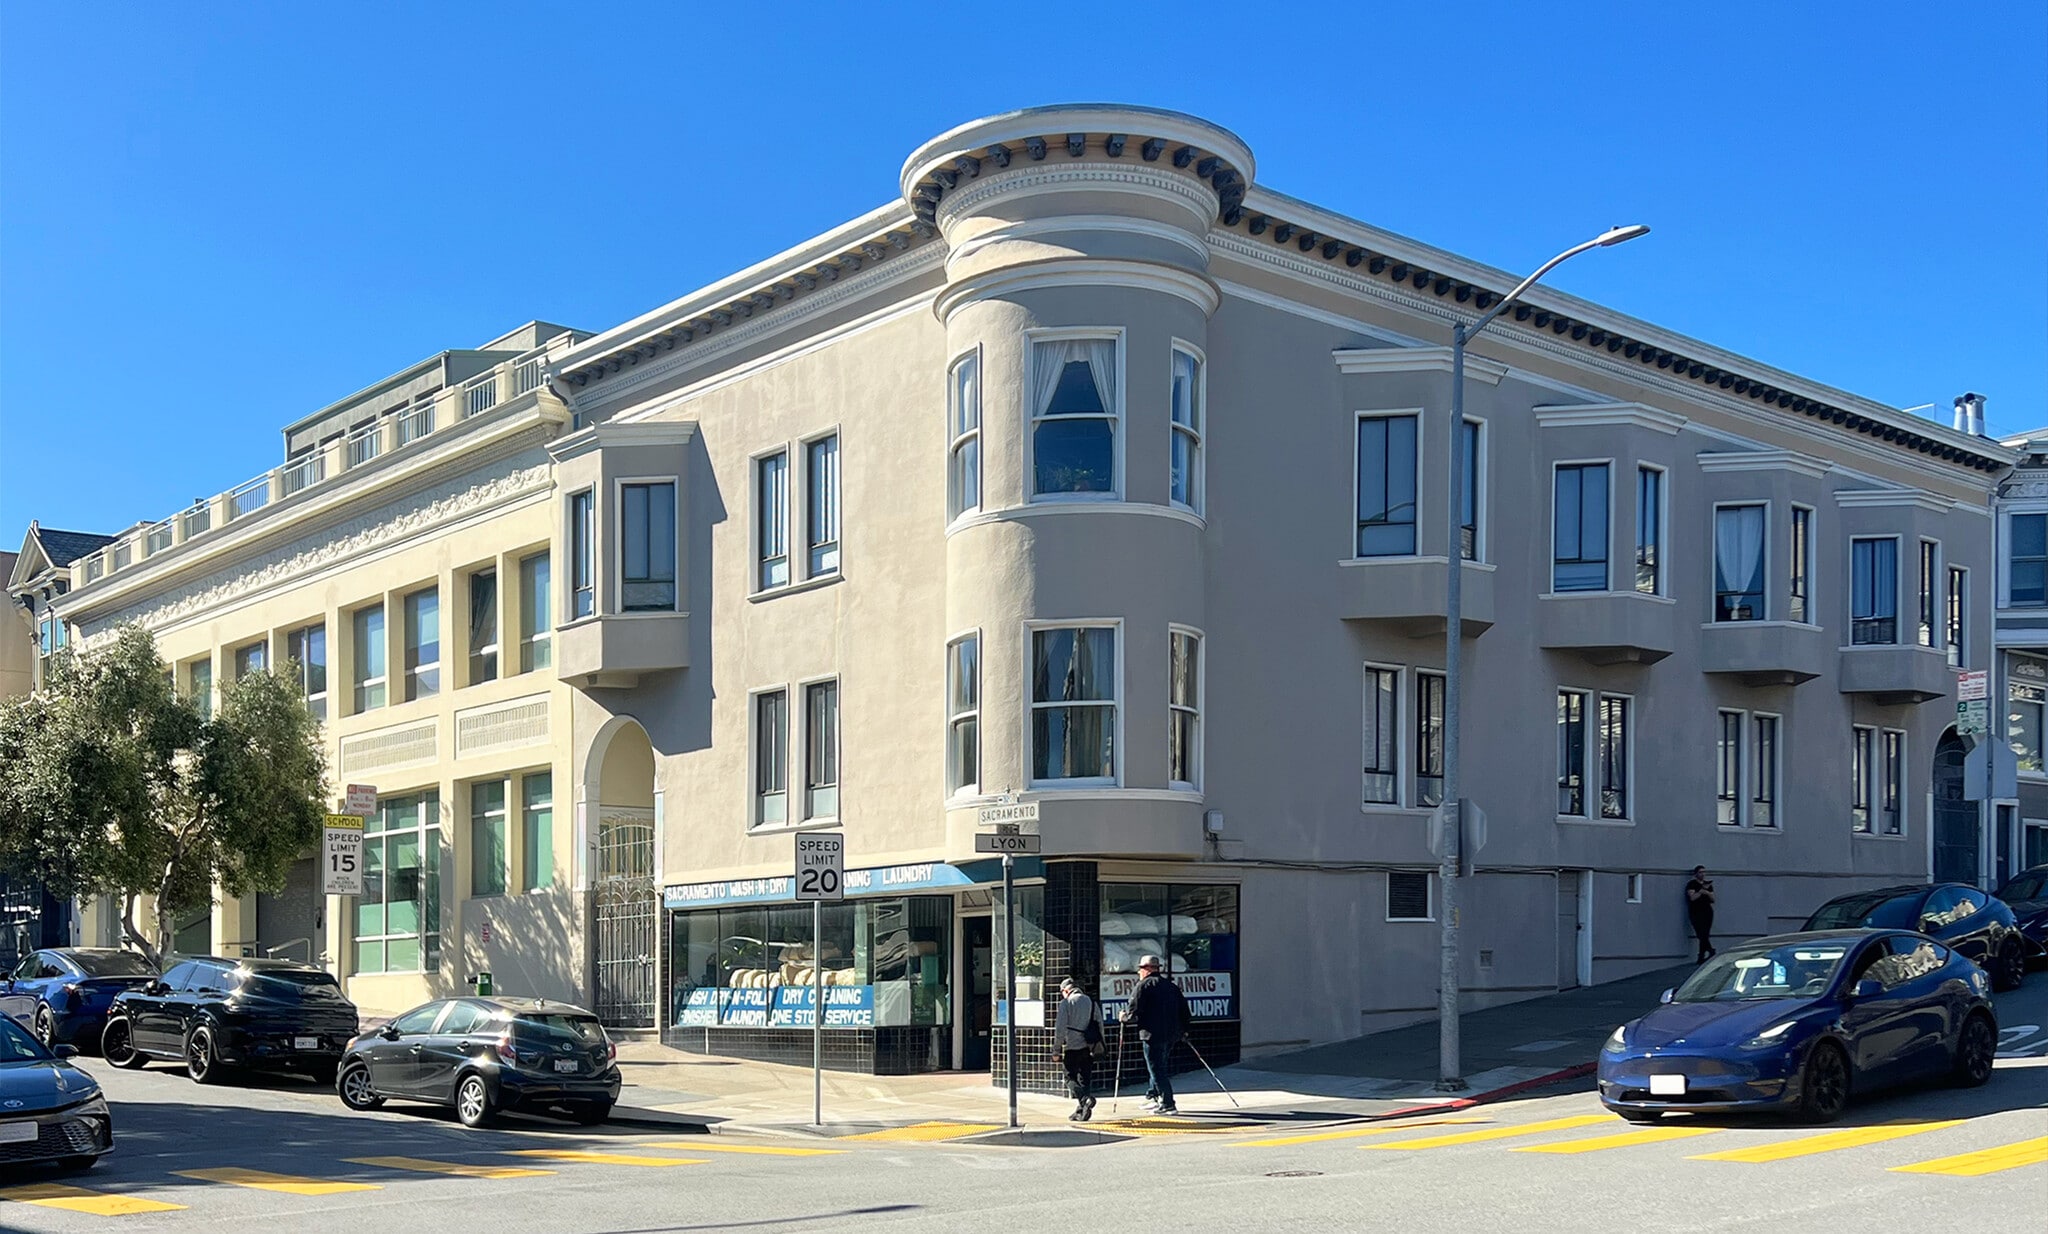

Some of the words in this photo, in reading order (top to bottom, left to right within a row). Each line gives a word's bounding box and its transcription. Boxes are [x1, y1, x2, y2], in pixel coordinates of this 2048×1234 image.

[327, 816, 361, 827] SCHOOL
[981, 806, 1035, 822] SACRAMENTO
[328, 833, 361, 842] SPEED
[799, 840, 840, 851] SPEED
[992, 838, 1026, 849] LYON
[330, 844, 357, 852] LIMIT
[331, 854, 355, 873] 15
[804, 855, 835, 865] LIMIT
[666, 883, 726, 901] SACRAMENTO
[843, 870, 872, 888] ANING
[882, 864, 934, 884] LAUNDRY
[801, 868, 838, 893] 20
[1177, 976, 1216, 993] ANING
[782, 988, 805, 1005] DRY
[808, 988, 862, 1005] CEANING
[1187, 999, 1230, 1017] UNDRY
[771, 1009, 793, 1025] ONE
[794, 1009, 823, 1025] STO
[825, 1009, 872, 1025] SERVICE
